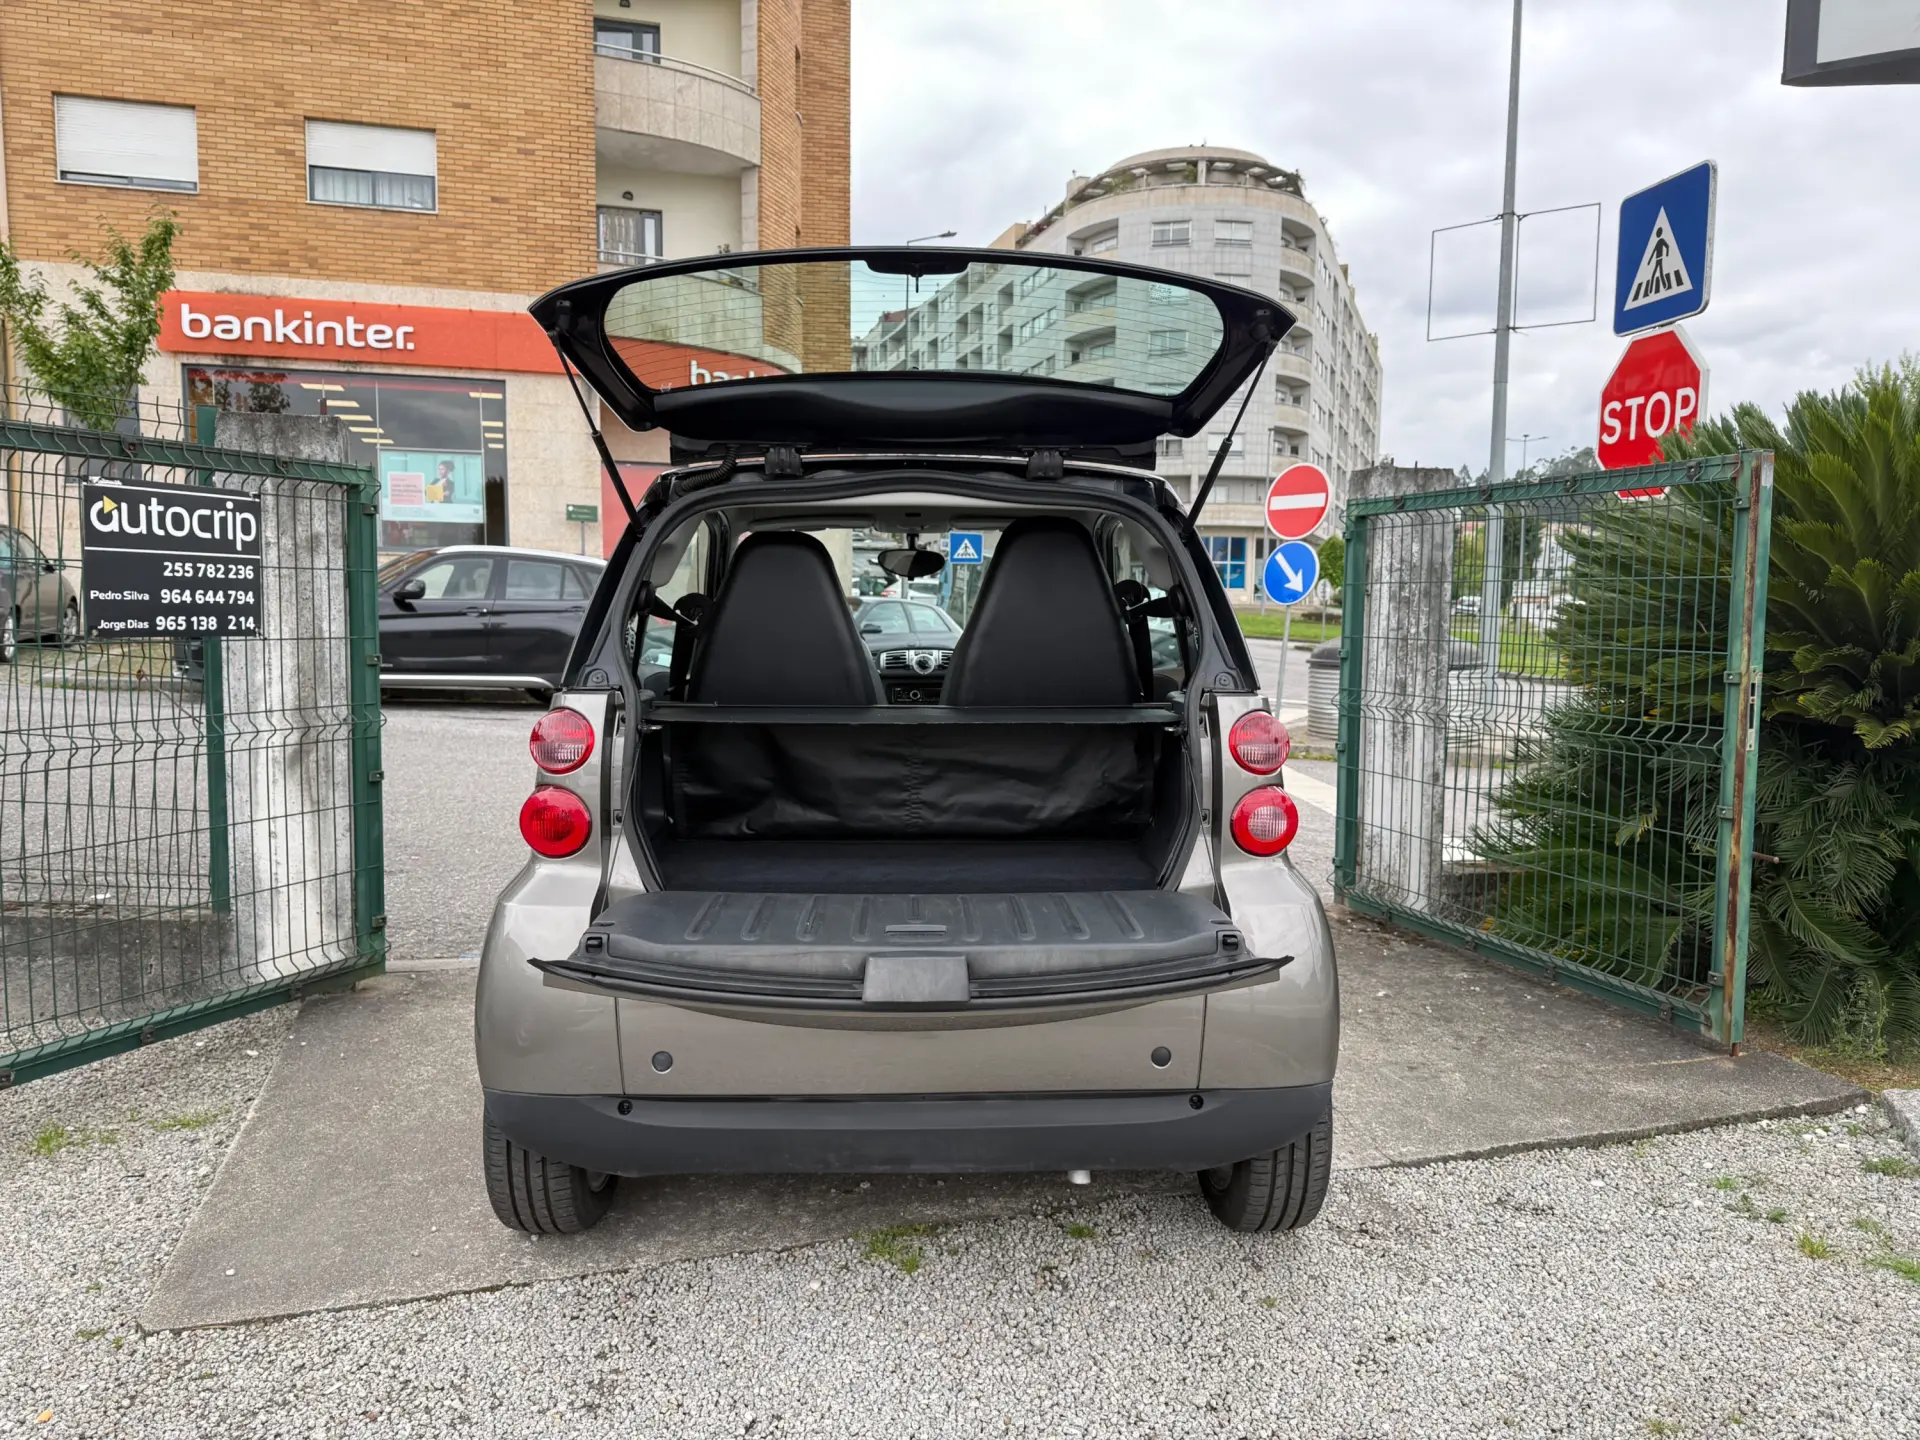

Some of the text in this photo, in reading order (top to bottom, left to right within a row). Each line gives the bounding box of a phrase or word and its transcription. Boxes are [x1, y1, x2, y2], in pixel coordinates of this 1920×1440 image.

[180, 303, 415, 350] bankinter.
[1600, 386, 1697, 445] STOP
[89, 496, 257, 551] autocrip
[163, 561, 254, 579] 255 782 236
[90, 589, 255, 605] Pedro Silva 964 644 794
[97, 619, 127, 632] Jorge
[127, 619, 150, 629] Dias
[155, 616, 187, 631] 965
[190, 616, 218, 631] 138
